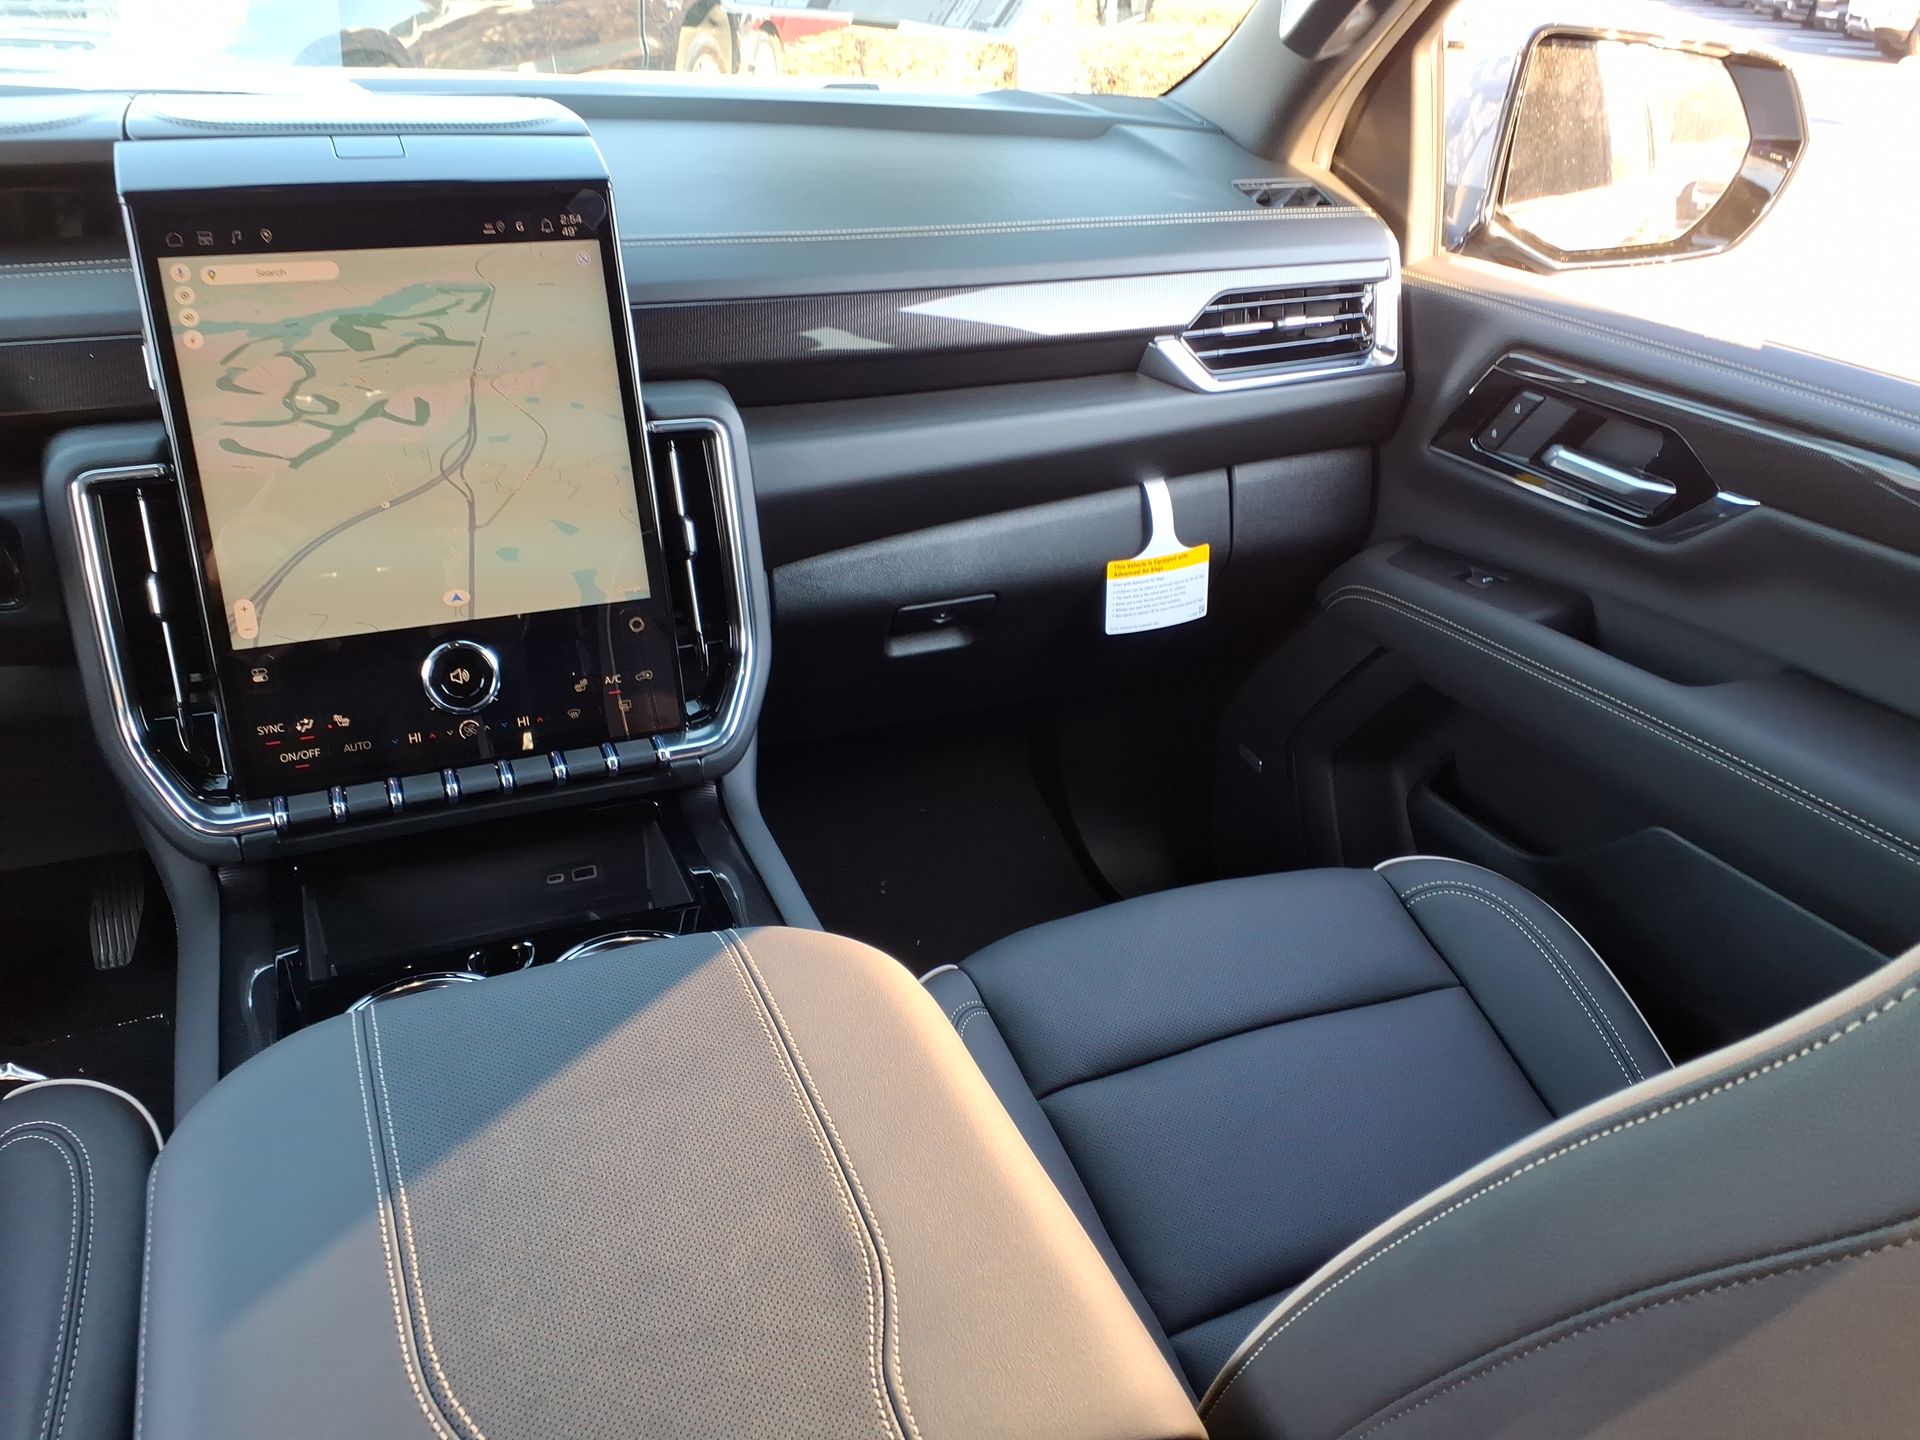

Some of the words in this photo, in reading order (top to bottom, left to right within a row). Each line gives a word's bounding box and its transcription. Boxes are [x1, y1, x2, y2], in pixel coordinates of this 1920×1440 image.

[256, 268, 287, 279] Search
[1114, 563, 1125, 571] This
[1127, 561, 1147, 570] Vehicle
[1153, 556, 1177, 567] Equipped
[1113, 569, 1141, 578] Advanced
[1150, 566, 1164, 574] Bags
[604, 673, 622, 686] A/C
[517, 715, 530, 728] HI
[257, 722, 285, 737] SYNC
[408, 732, 422, 745] HI
[343, 739, 372, 754] AUTO
[279, 747, 321, 764] ON/OFF
